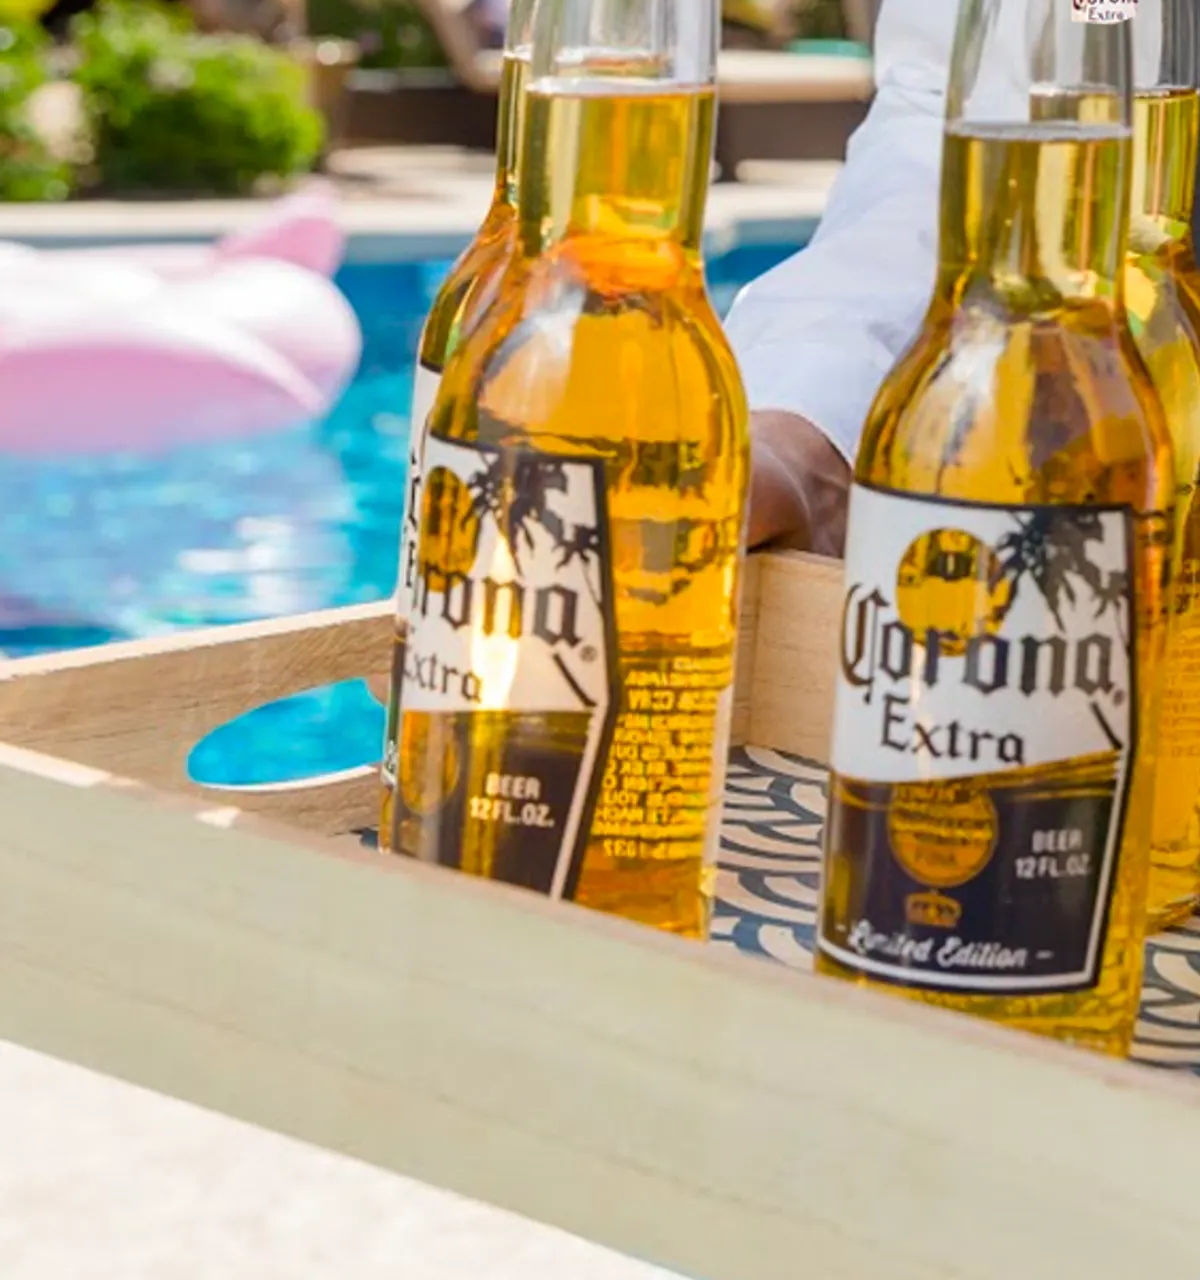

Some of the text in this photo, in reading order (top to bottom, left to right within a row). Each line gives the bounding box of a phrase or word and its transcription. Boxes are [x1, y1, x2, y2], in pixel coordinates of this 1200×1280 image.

[880, 692, 1025, 766] Extra
[484, 772, 541, 800] BEER
[935, 935, 1028, 968] Edition
